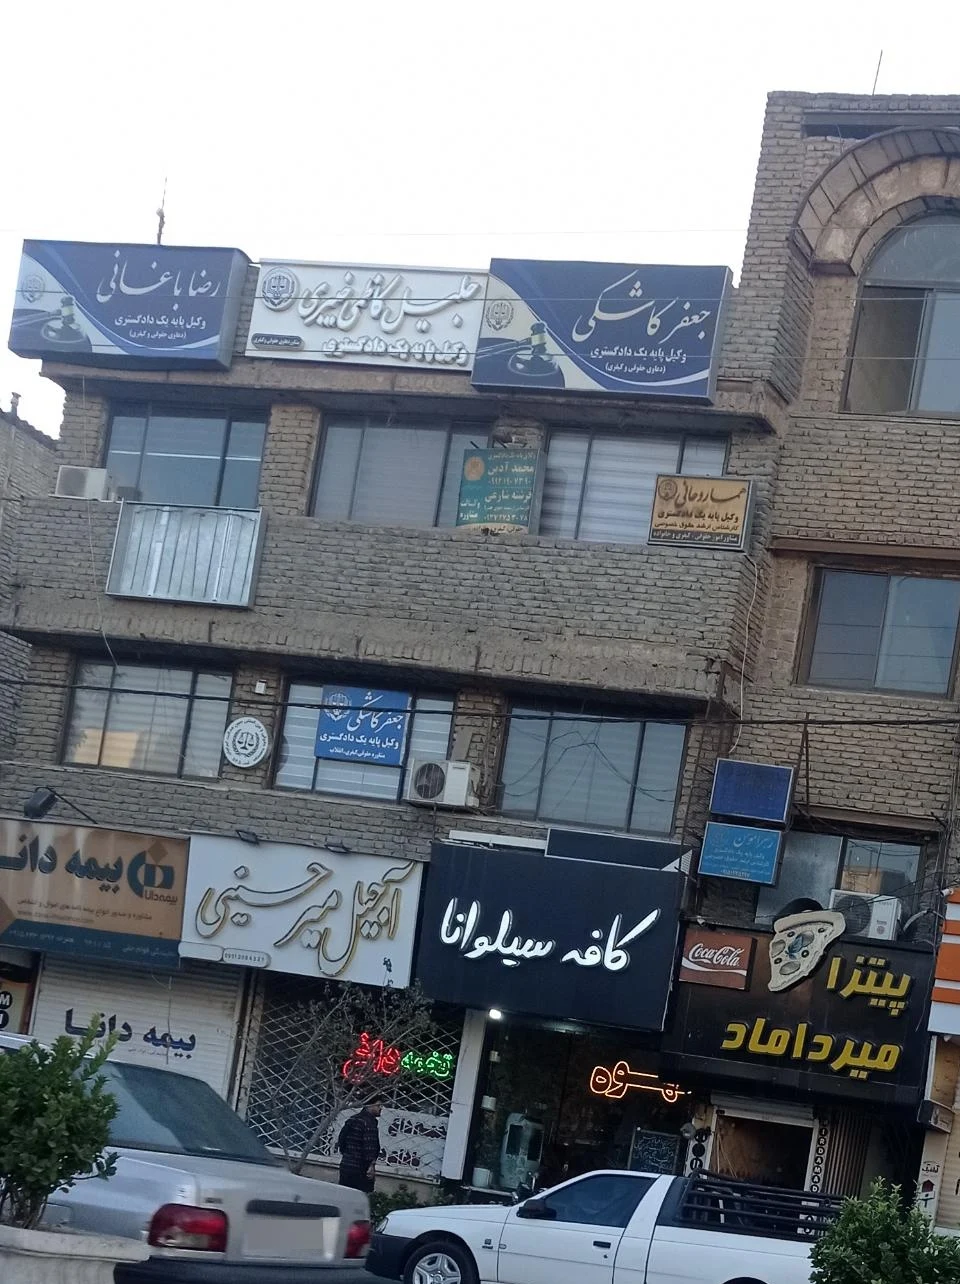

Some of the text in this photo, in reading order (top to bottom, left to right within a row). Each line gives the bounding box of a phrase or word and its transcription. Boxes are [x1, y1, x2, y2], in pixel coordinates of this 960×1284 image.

[95, 250, 221, 311] رضا باغانی
[337, 272, 403, 332] کاظمی
[115, 314, 207, 330] وکیل پایه یک دادگستری
[380, 274, 481, 334] جلیل
[572, 269, 711, 344] جعفر کاشکی
[323, 336, 470, 367] وکیل پایه یک دادگستری
[591, 346, 687, 363] وکیل پایه یک دادگستری
[628, 365, 646, 374] حقوقی
[511, 464, 534, 473] محمد
[674, 478, 709, 508] روحانی
[654, 520, 739, 532] کارشناس ارشد حقوق خصوصی
[658, 509, 739, 523] وکیل پایه یک دادگستری
[347, 691, 404, 734] جعفر کاشکی
[320, 730, 399, 750] وکیل پایه یک دادگستری
[0, 834, 123, 894] بیمه دان
[195, 861, 415, 977] آجیل میر حسینی
[440, 897, 662, 971] کافه سیلوانا
[688, 942, 745, 967] Coca-Cola
[826, 954, 912, 1016] پیتزا
[64, 1007, 197, 1061] بیمه دانا
[720, 1017, 903, 1081] میرداماد
